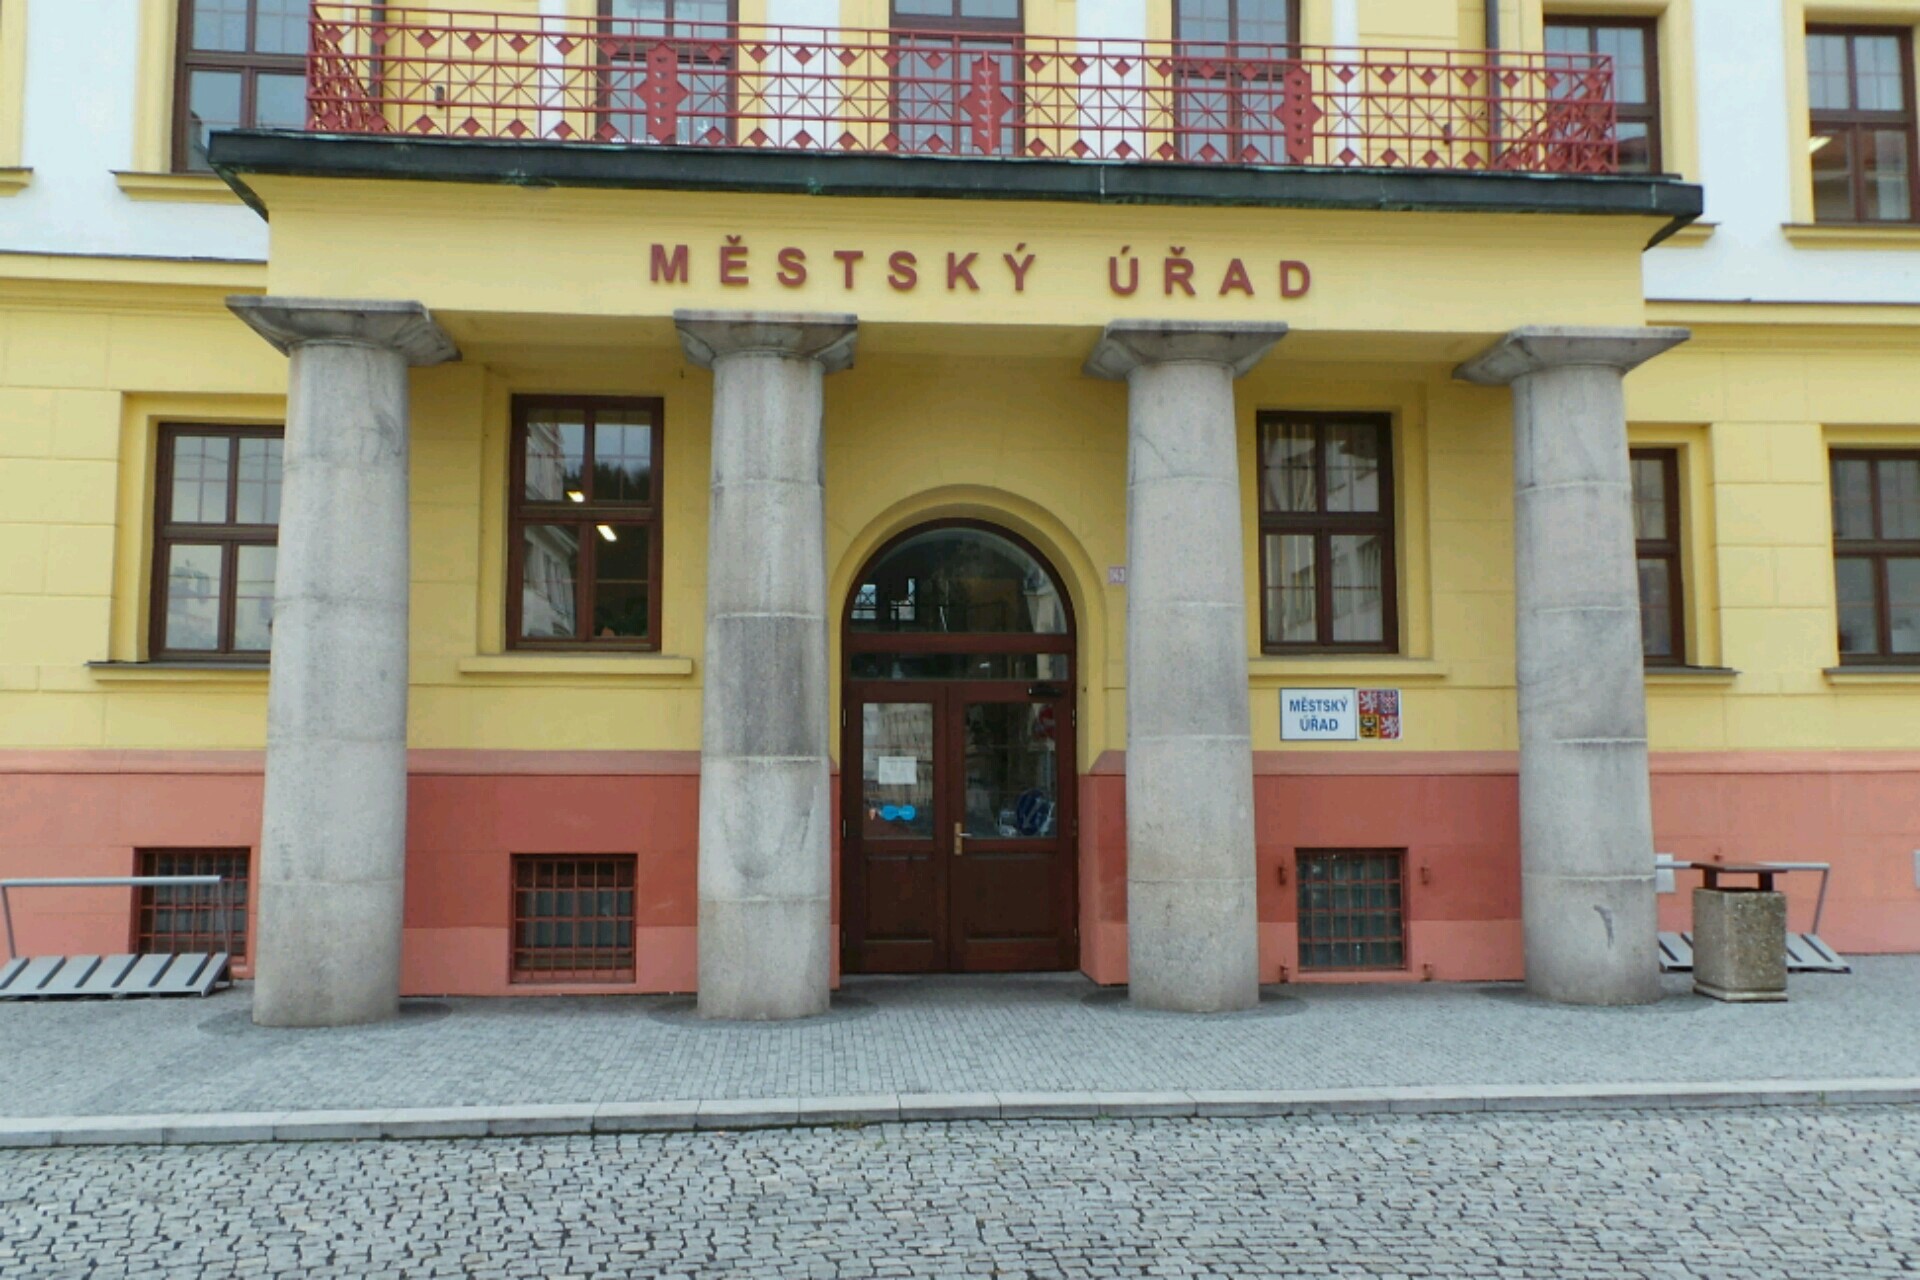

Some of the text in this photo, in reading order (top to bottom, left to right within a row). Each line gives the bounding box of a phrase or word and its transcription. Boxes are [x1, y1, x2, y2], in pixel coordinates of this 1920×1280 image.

[650, 235, 1311, 298] MĚSTSKÝ ÚŘAD
[1289, 697, 1348, 712] MĚSTSKÝ
[1300, 715, 1338, 731] ÚŘAD
